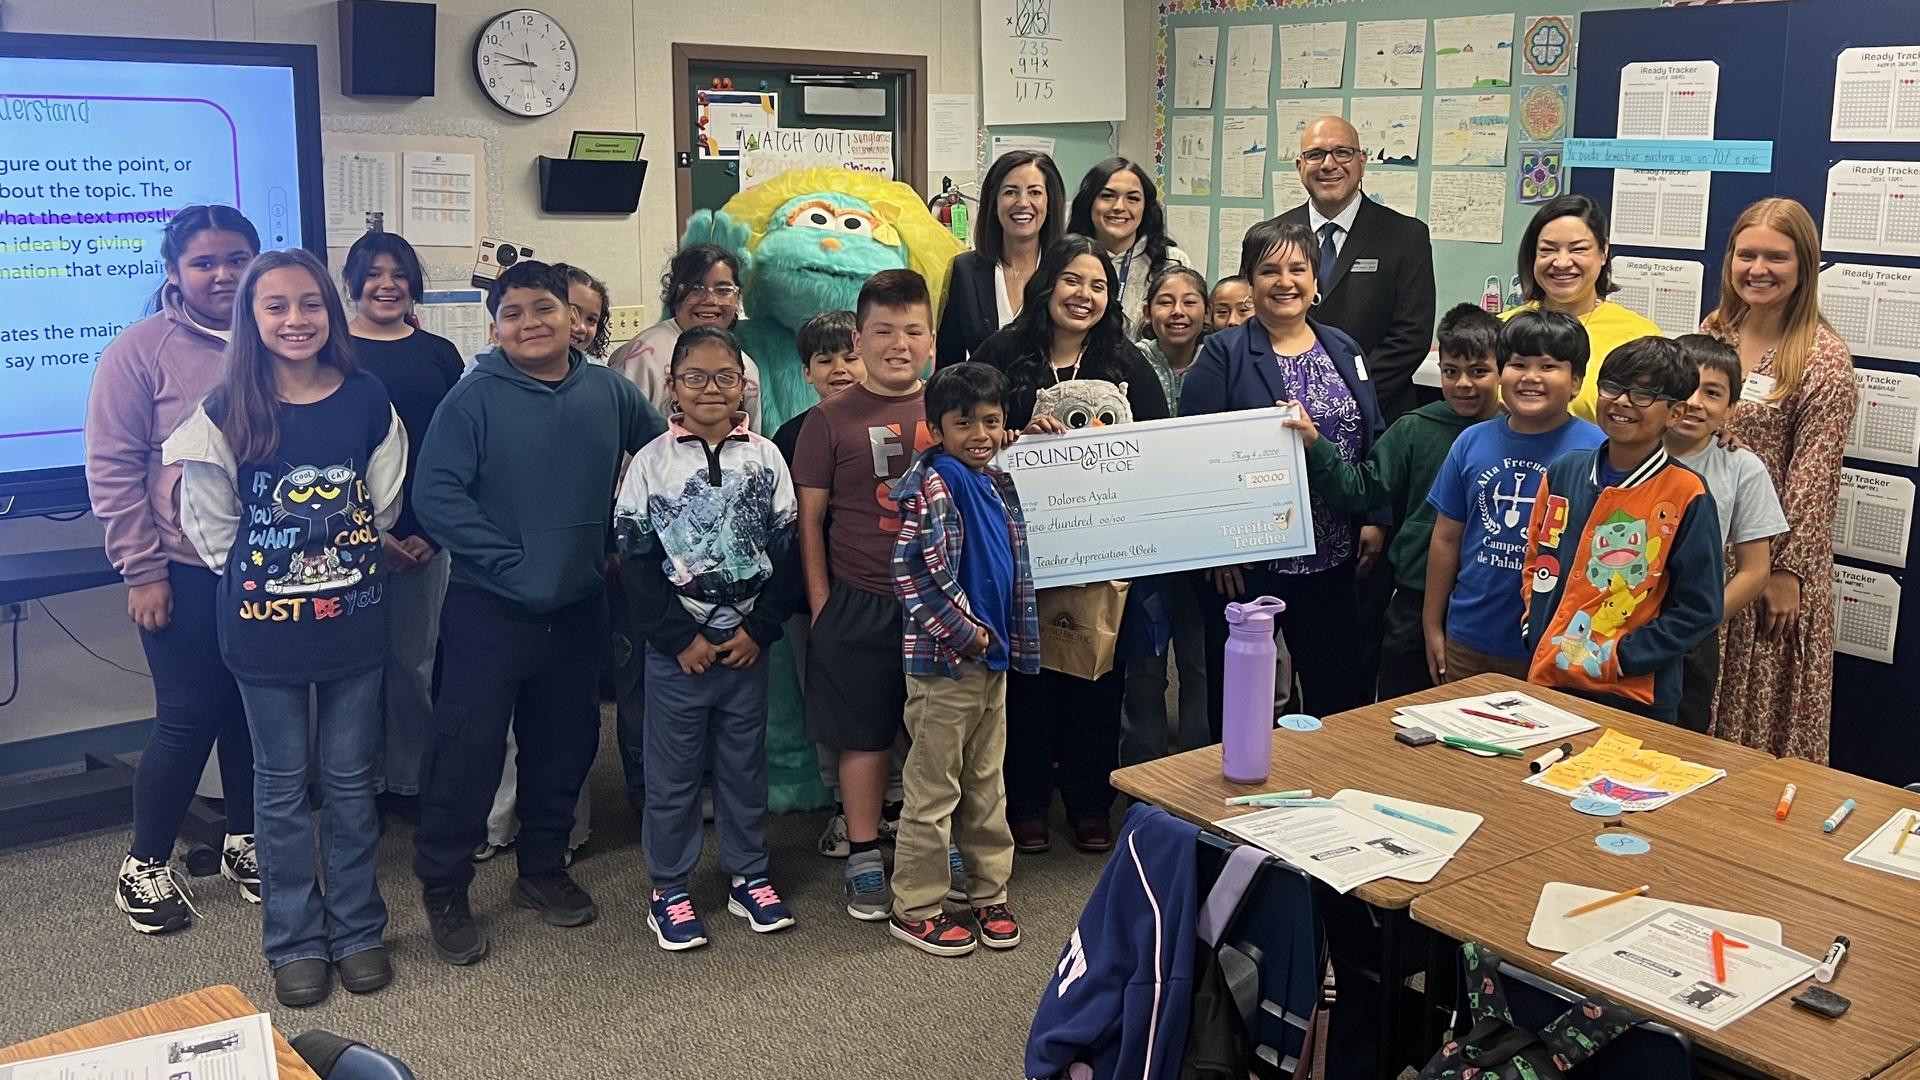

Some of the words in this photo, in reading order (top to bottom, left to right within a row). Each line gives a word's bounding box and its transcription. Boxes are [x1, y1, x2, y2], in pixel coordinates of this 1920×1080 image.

[500, 20, 511, 31] 11
[521, 15, 534, 26] 12
[486, 34, 498, 45] 10
[559, 40, 567, 51] 2
[1019, 39, 1049, 56] 235
[482, 55, 490, 66] 9
[1861, 52, 1894, 61] iReady
[564, 61, 571, 72] 3
[1640, 66, 1667, 75] iReady
[1668, 66, 1698, 74] Tracker
[489, 78, 496, 88] 8
[558, 82, 566, 92] 4
[503, 94, 511, 105] 7
[545, 97, 552, 108] 5
[524, 102, 532, 112] 6
[45, 157, 77, 172] out
[82, 155, 113, 172] the
[118, 156, 170, 175] point,
[174, 159, 192, 172] or
[1851, 165, 1885, 176] iReady
[49, 182, 80, 198] the
[86, 183, 136, 201] topic.
[139, 182, 173, 197] The
[41, 208, 71, 225] the
[77, 210, 113, 224] text
[13, 236, 53, 252] idea
[59, 236, 82, 254] by
[87, 236, 144, 254] giving
[65, 262, 102, 277] that
[1626, 261, 1653, 272] iReady
[1653, 263, 1683, 272] Tracker
[1841, 268, 1874, 280] iReady
[1875, 271, 1913, 281] Tracker
[43, 324, 74, 340] the
[80, 322, 123, 338] main
[5, 356, 35, 371] say
[41, 351, 89, 366] more
[1865, 374, 1902, 386] Tracker
[1014, 439, 1141, 468] FOUNDATION
[1100, 459, 1135, 474] FCOE
[293, 470, 315, 482] COOL
[331, 470, 346, 480] CAT
[1237, 474, 1243, 482] $
[1251, 472, 1285, 484] 200.00
[1477, 466, 1500, 489] Alta
[1855, 474, 1891, 487] Tracker
[252, 471, 272, 498] IF
[1047, 492, 1087, 507] Dolores
[1088, 487, 1118, 506] Ayala
[248, 504, 273, 527] YOU
[1025, 520, 1046, 533] Two
[1047, 513, 1094, 532] Hundred
[1219, 520, 1275, 537] Terrific
[248, 526, 301, 550] WANT
[334, 524, 379, 546] COOL
[1232, 532, 1289, 549] Teacher
[1033, 553, 1069, 569] Teacher
[1070, 548, 1128, 566] Appreciation
[1128, 542, 1158, 556] Week
[1477, 551, 1488, 564] de
[1841, 570, 1877, 584] Tracker
[239, 597, 307, 622] JUST
[311, 596, 343, 620] BE
[344, 582, 383, 616] YOU
